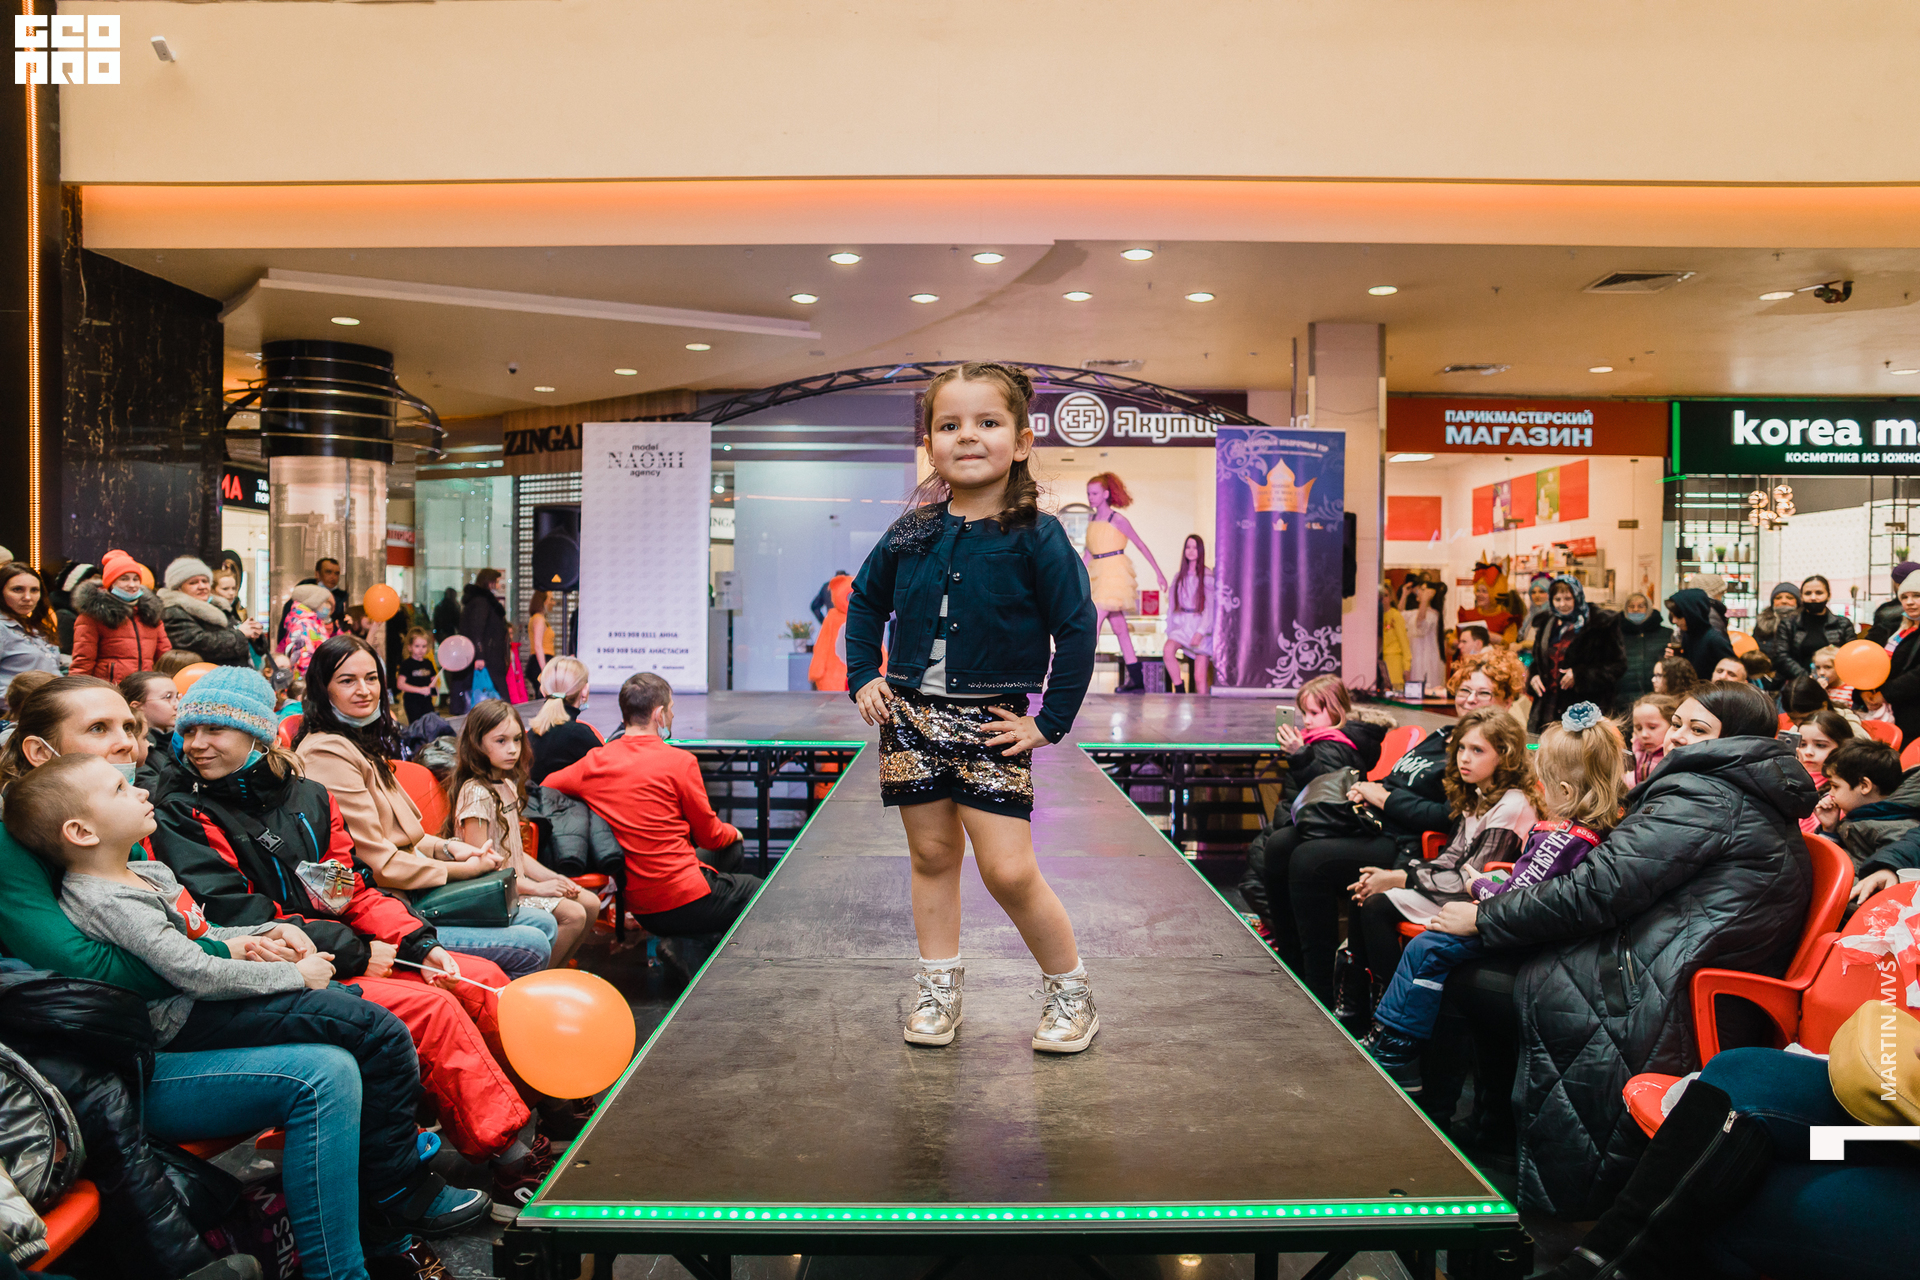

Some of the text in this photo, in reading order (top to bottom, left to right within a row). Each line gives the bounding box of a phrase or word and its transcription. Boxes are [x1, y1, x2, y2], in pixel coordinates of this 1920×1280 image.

[1445, 409, 1594, 425] ПАРИКМАСТЕРСКИЙ
[1732, 409, 1920, 446] korea m
[1445, 425, 1593, 447] МАГАЗИН
[632, 443, 659, 451] model
[607, 452, 684, 469] NAOMI
[1785, 452, 1860, 463] косметика
[1862, 452, 1880, 463] из
[630, 469, 661, 477] agency
